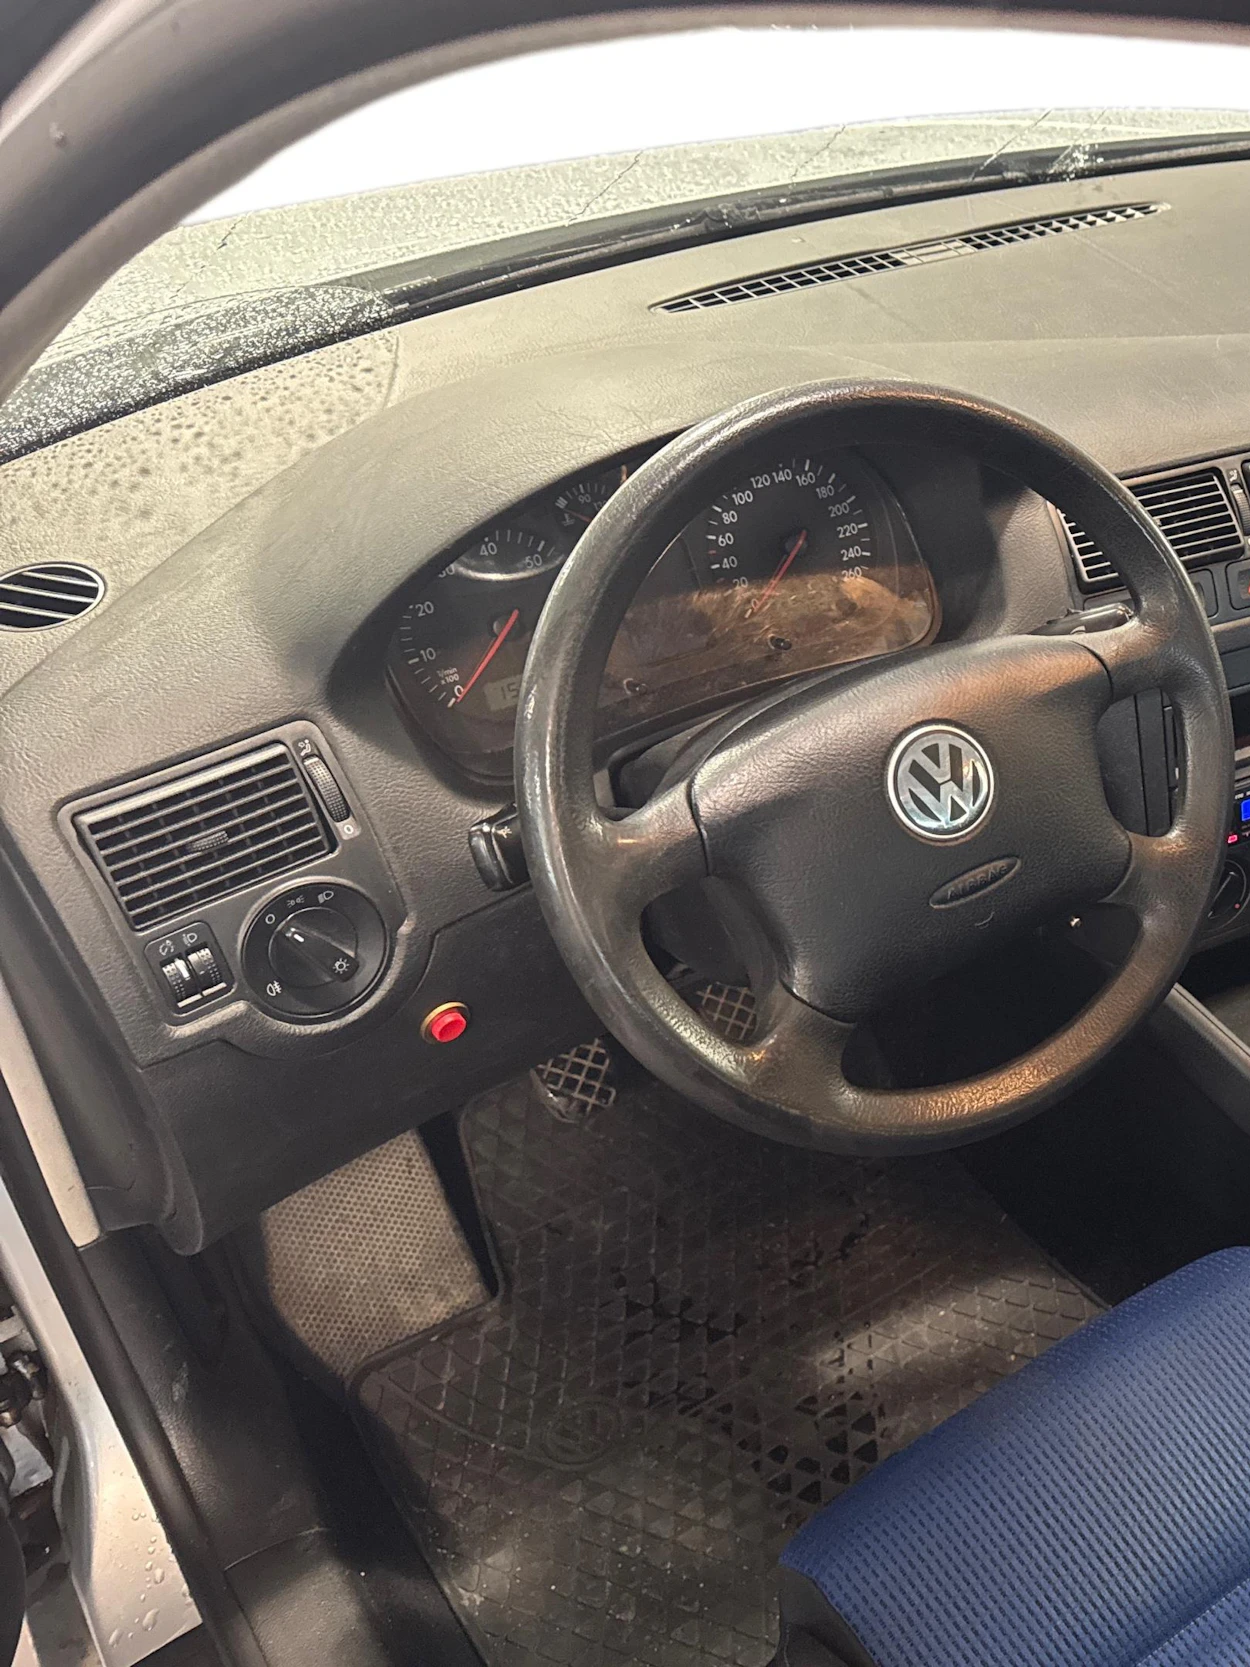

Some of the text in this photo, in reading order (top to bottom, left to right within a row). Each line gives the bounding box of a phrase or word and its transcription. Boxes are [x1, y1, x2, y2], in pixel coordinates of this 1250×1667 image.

[750, 474, 771, 489] 120
[772, 468, 792, 483] 140
[795, 472, 816, 487] 160
[578, 494, 592, 504] 90
[732, 491, 754, 505] 100
[816, 485, 835, 499] 180
[828, 502, 850, 517] 200
[722, 510, 738, 525] 80
[837, 523, 858, 538] 220
[718, 532, 734, 547] 60
[480, 542, 498, 557] 40
[840, 546, 862, 561] 240
[525, 553, 543, 569] 50
[722, 556, 738, 569] 40
[841, 566, 862, 580] 260
[732, 576, 749, 589] 20
[415, 601, 434, 617] 20
[420, 647, 436, 662] 10
[454, 684, 464, 697] 0
